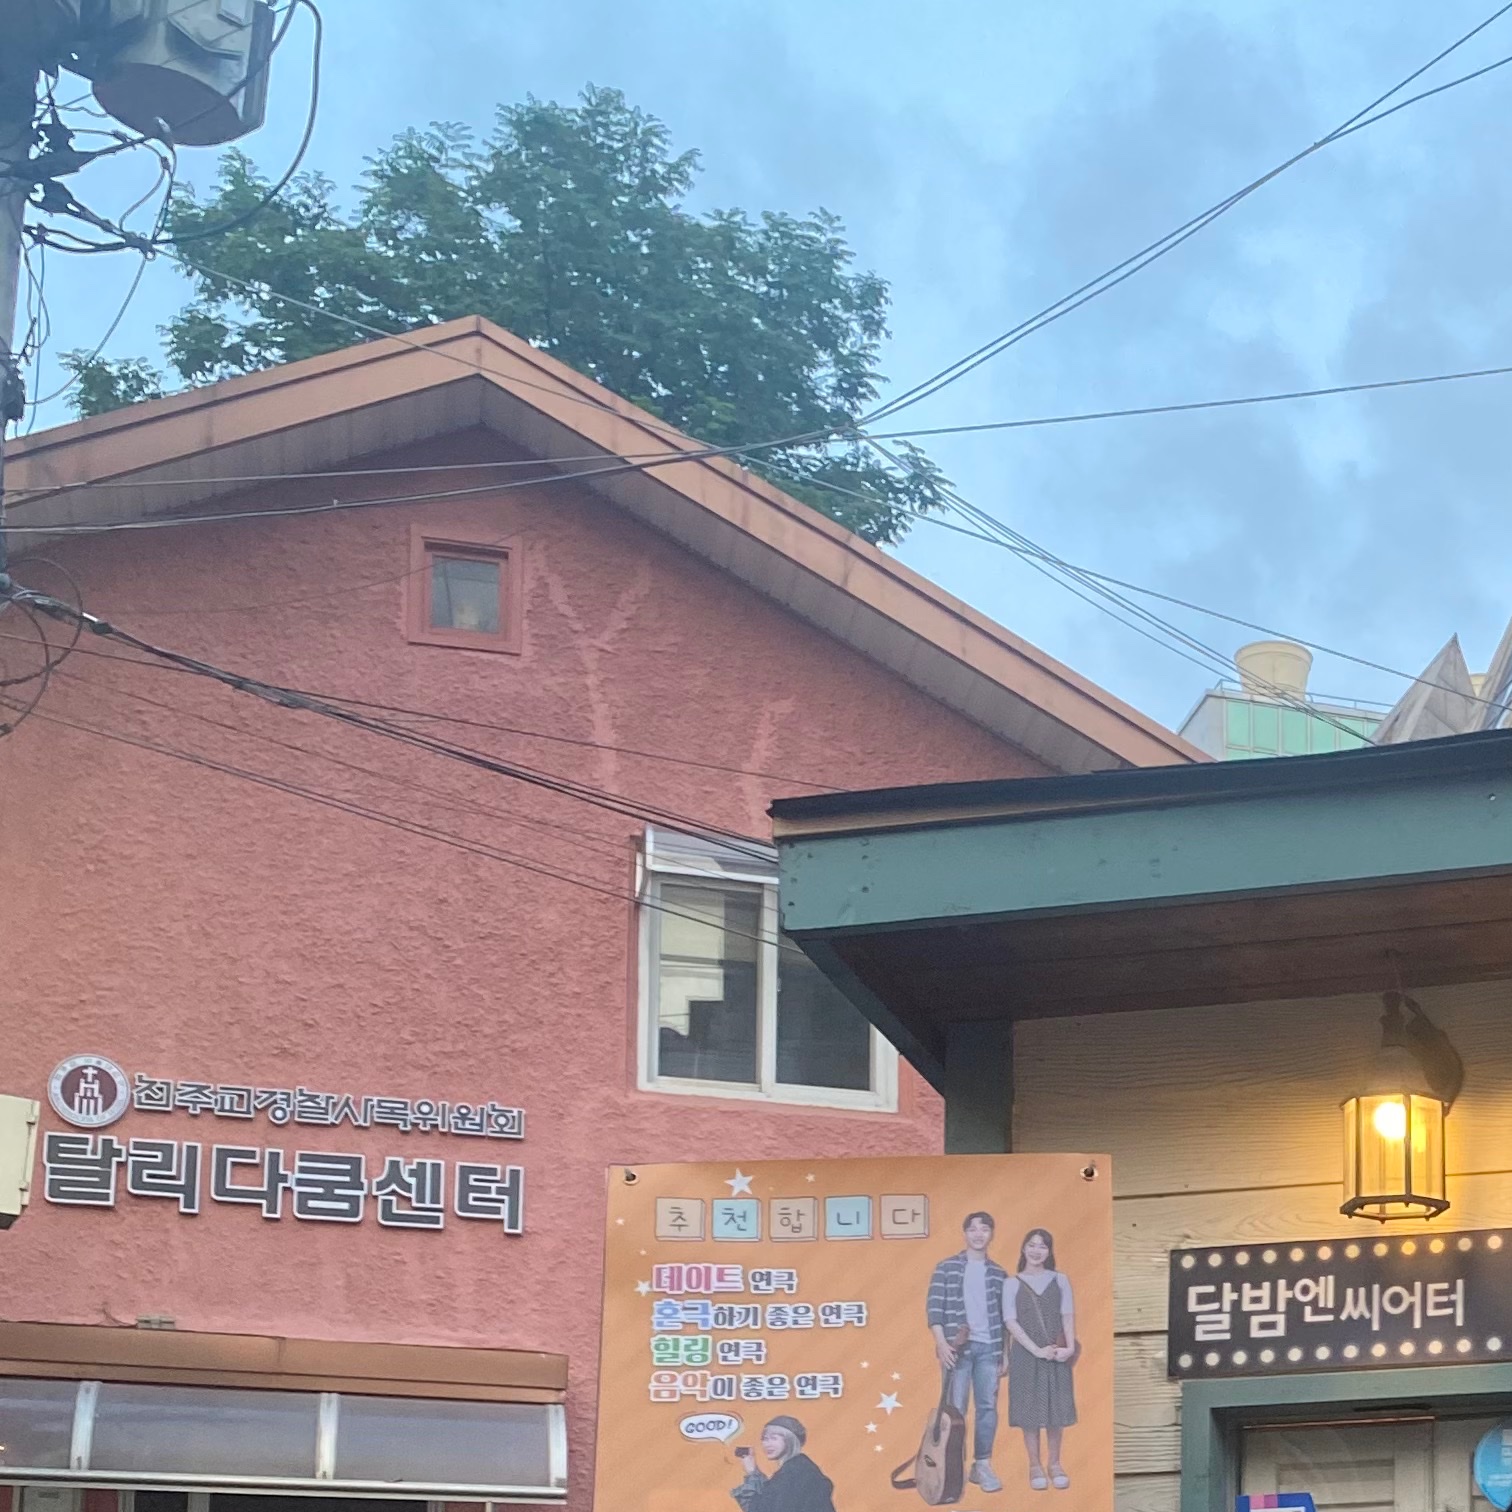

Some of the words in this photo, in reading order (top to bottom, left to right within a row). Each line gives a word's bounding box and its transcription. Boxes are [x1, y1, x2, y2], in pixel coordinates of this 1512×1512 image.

[133, 1072, 526, 1140] 천주교경찰사목위원회
[42, 1131, 526, 1236] 탈리다쿰센터
[666, 1205, 921, 1232] 추천합니다
[654, 1264, 744, 1293] 데이트
[750, 1269, 797, 1293] 연극
[766, 1303, 814, 1329] 좋은
[820, 1302, 868, 1326] 연극
[1186, 1274, 1465, 1342] 달밤엔씨어터
[652, 1336, 712, 1365] 힐링
[718, 1340, 766, 1364] 연극
[650, 1371, 736, 1400] 음악이
[741, 1374, 790, 1399] 좋은
[795, 1373, 842, 1398] 연극
[684, 1418, 735, 1435] GOOD!
